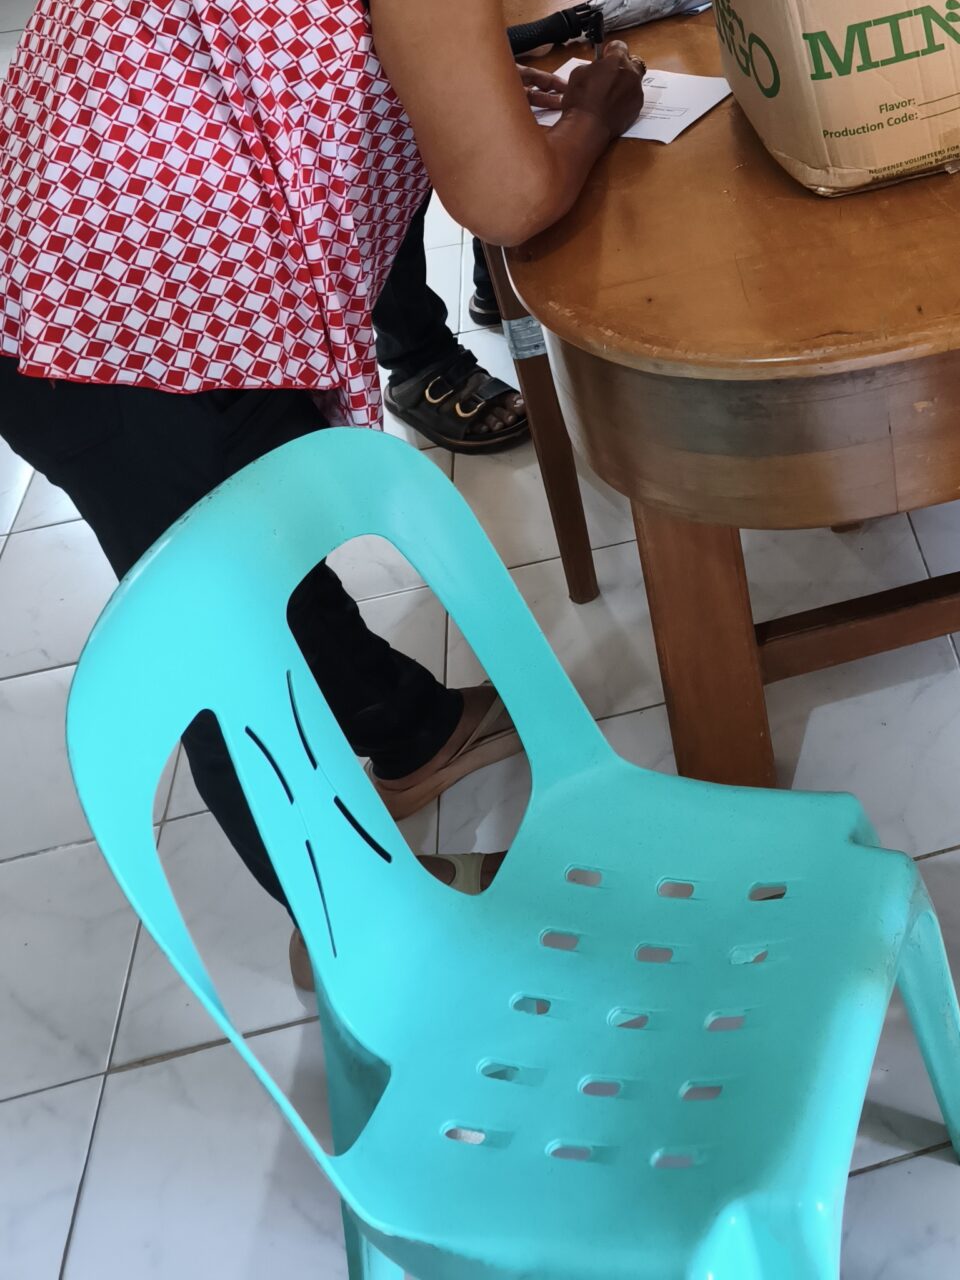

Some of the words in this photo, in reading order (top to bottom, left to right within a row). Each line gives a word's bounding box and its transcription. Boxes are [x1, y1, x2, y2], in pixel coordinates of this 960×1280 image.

[879, 98, 917, 114] Flavor:
[823, 121, 884, 140] Production
[887, 112, 919, 127] Code:
[869, 162, 903, 174] NEGRENSE
[904, 149, 946, 166] VOLUNTEERS
[947, 145, 960, 154] FOR
